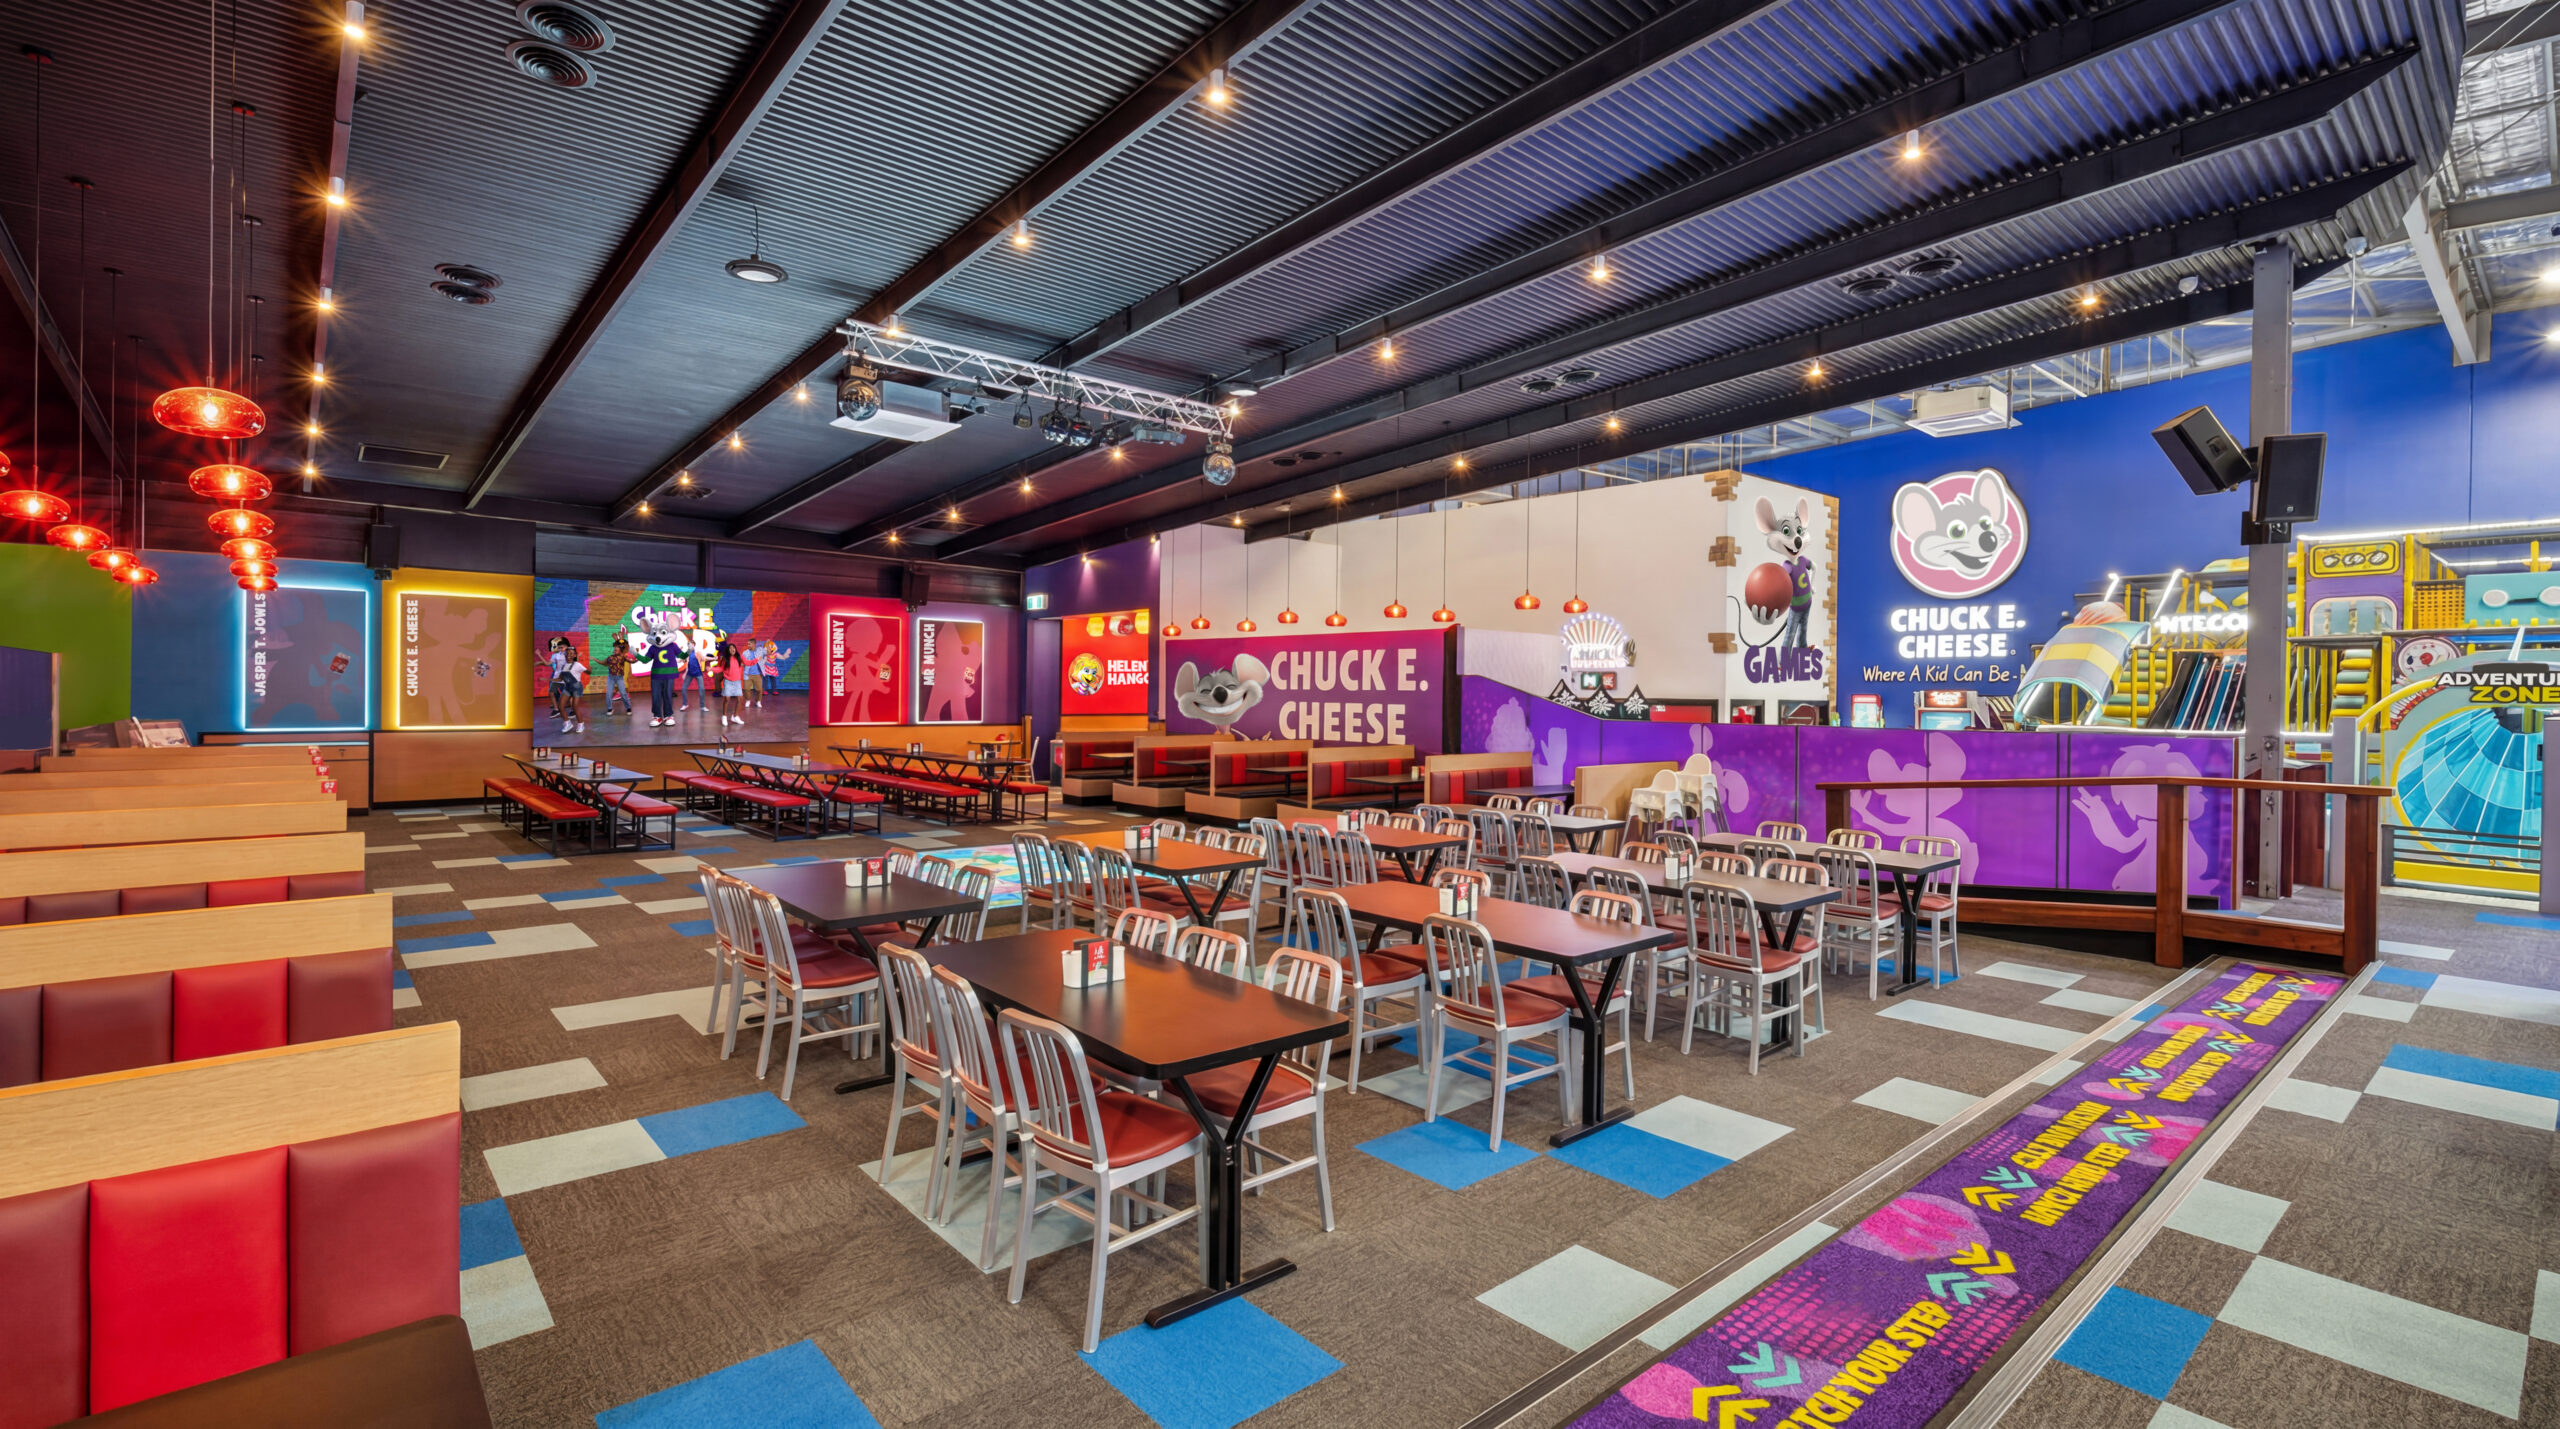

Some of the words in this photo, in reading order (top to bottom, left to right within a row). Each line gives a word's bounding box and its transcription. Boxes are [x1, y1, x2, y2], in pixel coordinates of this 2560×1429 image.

[254, 593, 267, 634] JOWLS
[662, 593, 686, 606] The
[406, 600, 418, 642] CHEESE
[631, 606, 697, 630] Chuk
[698, 608, 718, 630] E.
[1890, 606, 1991, 632] CHUCK
[1998, 604, 2026, 629] E.
[254, 637, 267, 648] T.
[406, 645, 418, 655] E.
[832, 620, 844, 658] HENNY
[923, 623, 936, 664] MUNCH
[254, 651, 267, 696] JASPER
[406, 659, 418, 696] CHUCK
[832, 661, 844, 697] HELEN
[923, 669, 936, 686] MR
[1270, 649, 1386, 691] CHUCK
[1397, 648, 1429, 692] E.
[1744, 645, 1824, 683] GAMES
[1863, 664, 1905, 682] Where
[1909, 664, 1921, 682] A
[1925, 664, 1949, 682] Kid
[1954, 665, 1983, 682] Can
[1989, 664, 2010, 682] Be
[2437, 672, 2560, 686] ADVENTU
[2471, 686, 2560, 702] ZONE
[1278, 700, 1406, 745] CHEESE
[1828, 1339, 1913, 1405] YOUR
[1884, 1301, 1953, 1348] STEP
